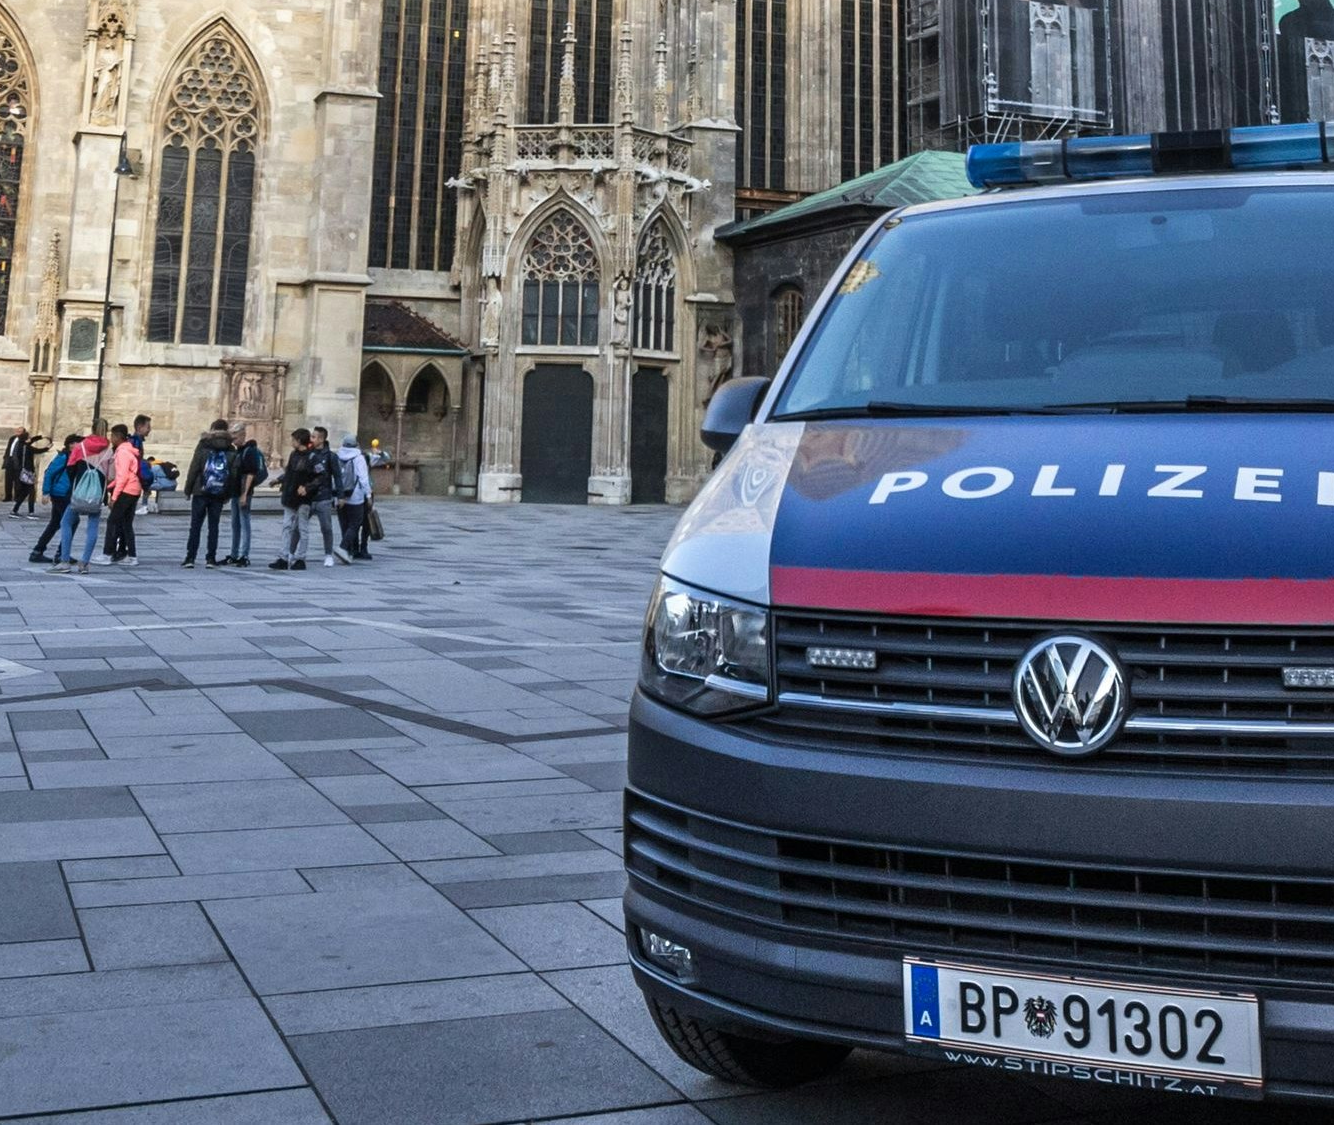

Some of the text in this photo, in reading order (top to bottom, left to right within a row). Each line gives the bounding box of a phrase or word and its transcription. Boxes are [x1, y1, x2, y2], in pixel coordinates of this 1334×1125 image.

[920, 1010, 933, 1027] A
[959, 981, 1226, 1065] BP 91302
